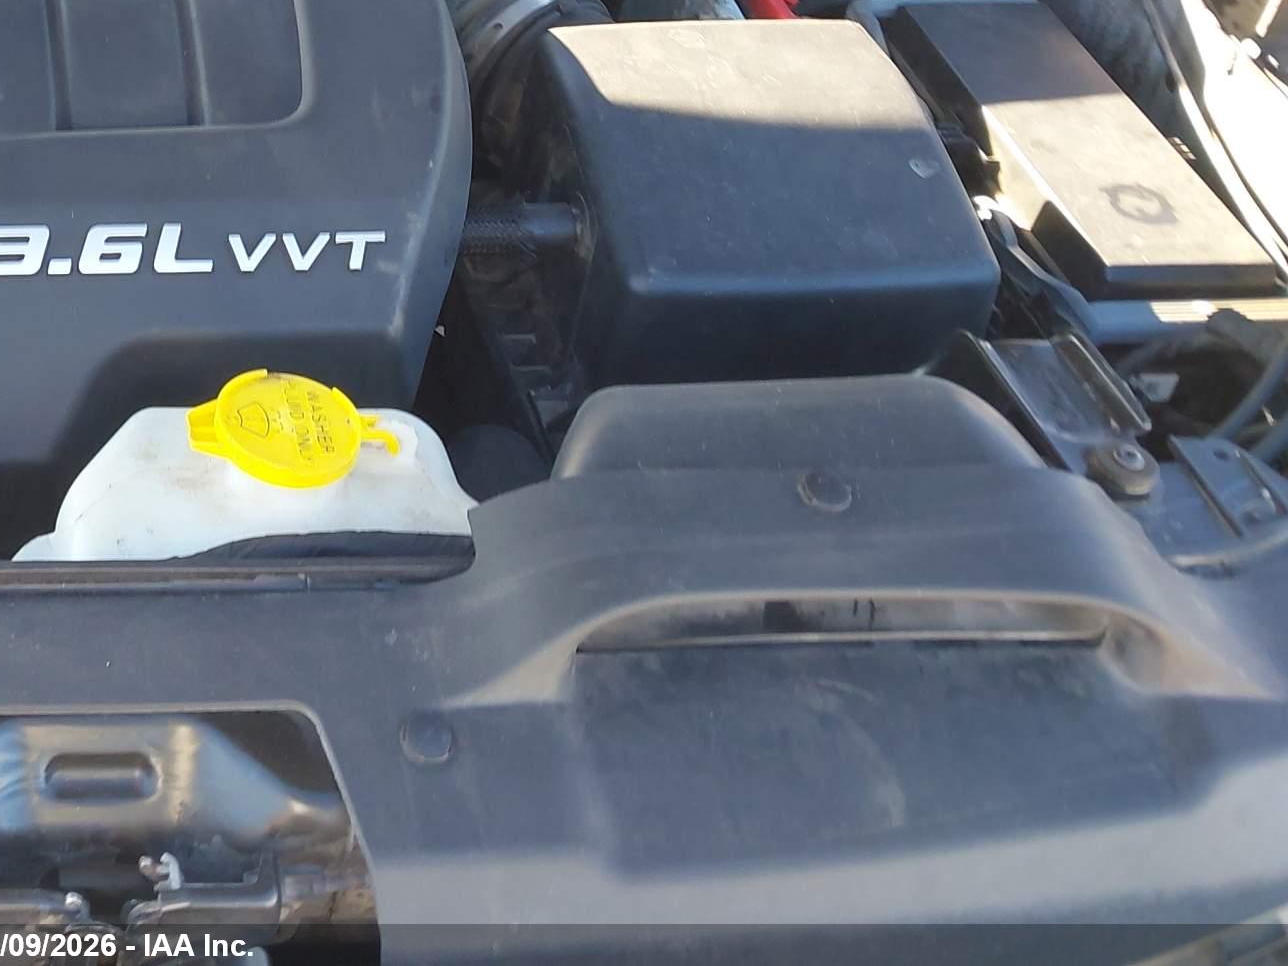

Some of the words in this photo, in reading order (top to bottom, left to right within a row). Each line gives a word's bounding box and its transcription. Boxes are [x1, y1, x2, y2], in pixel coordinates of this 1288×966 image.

[228, 230, 385, 272] VVT
[280, 379, 305, 420] FLUID
[293, 424, 314, 463] ONLY
[306, 390, 335, 453] WASHER
